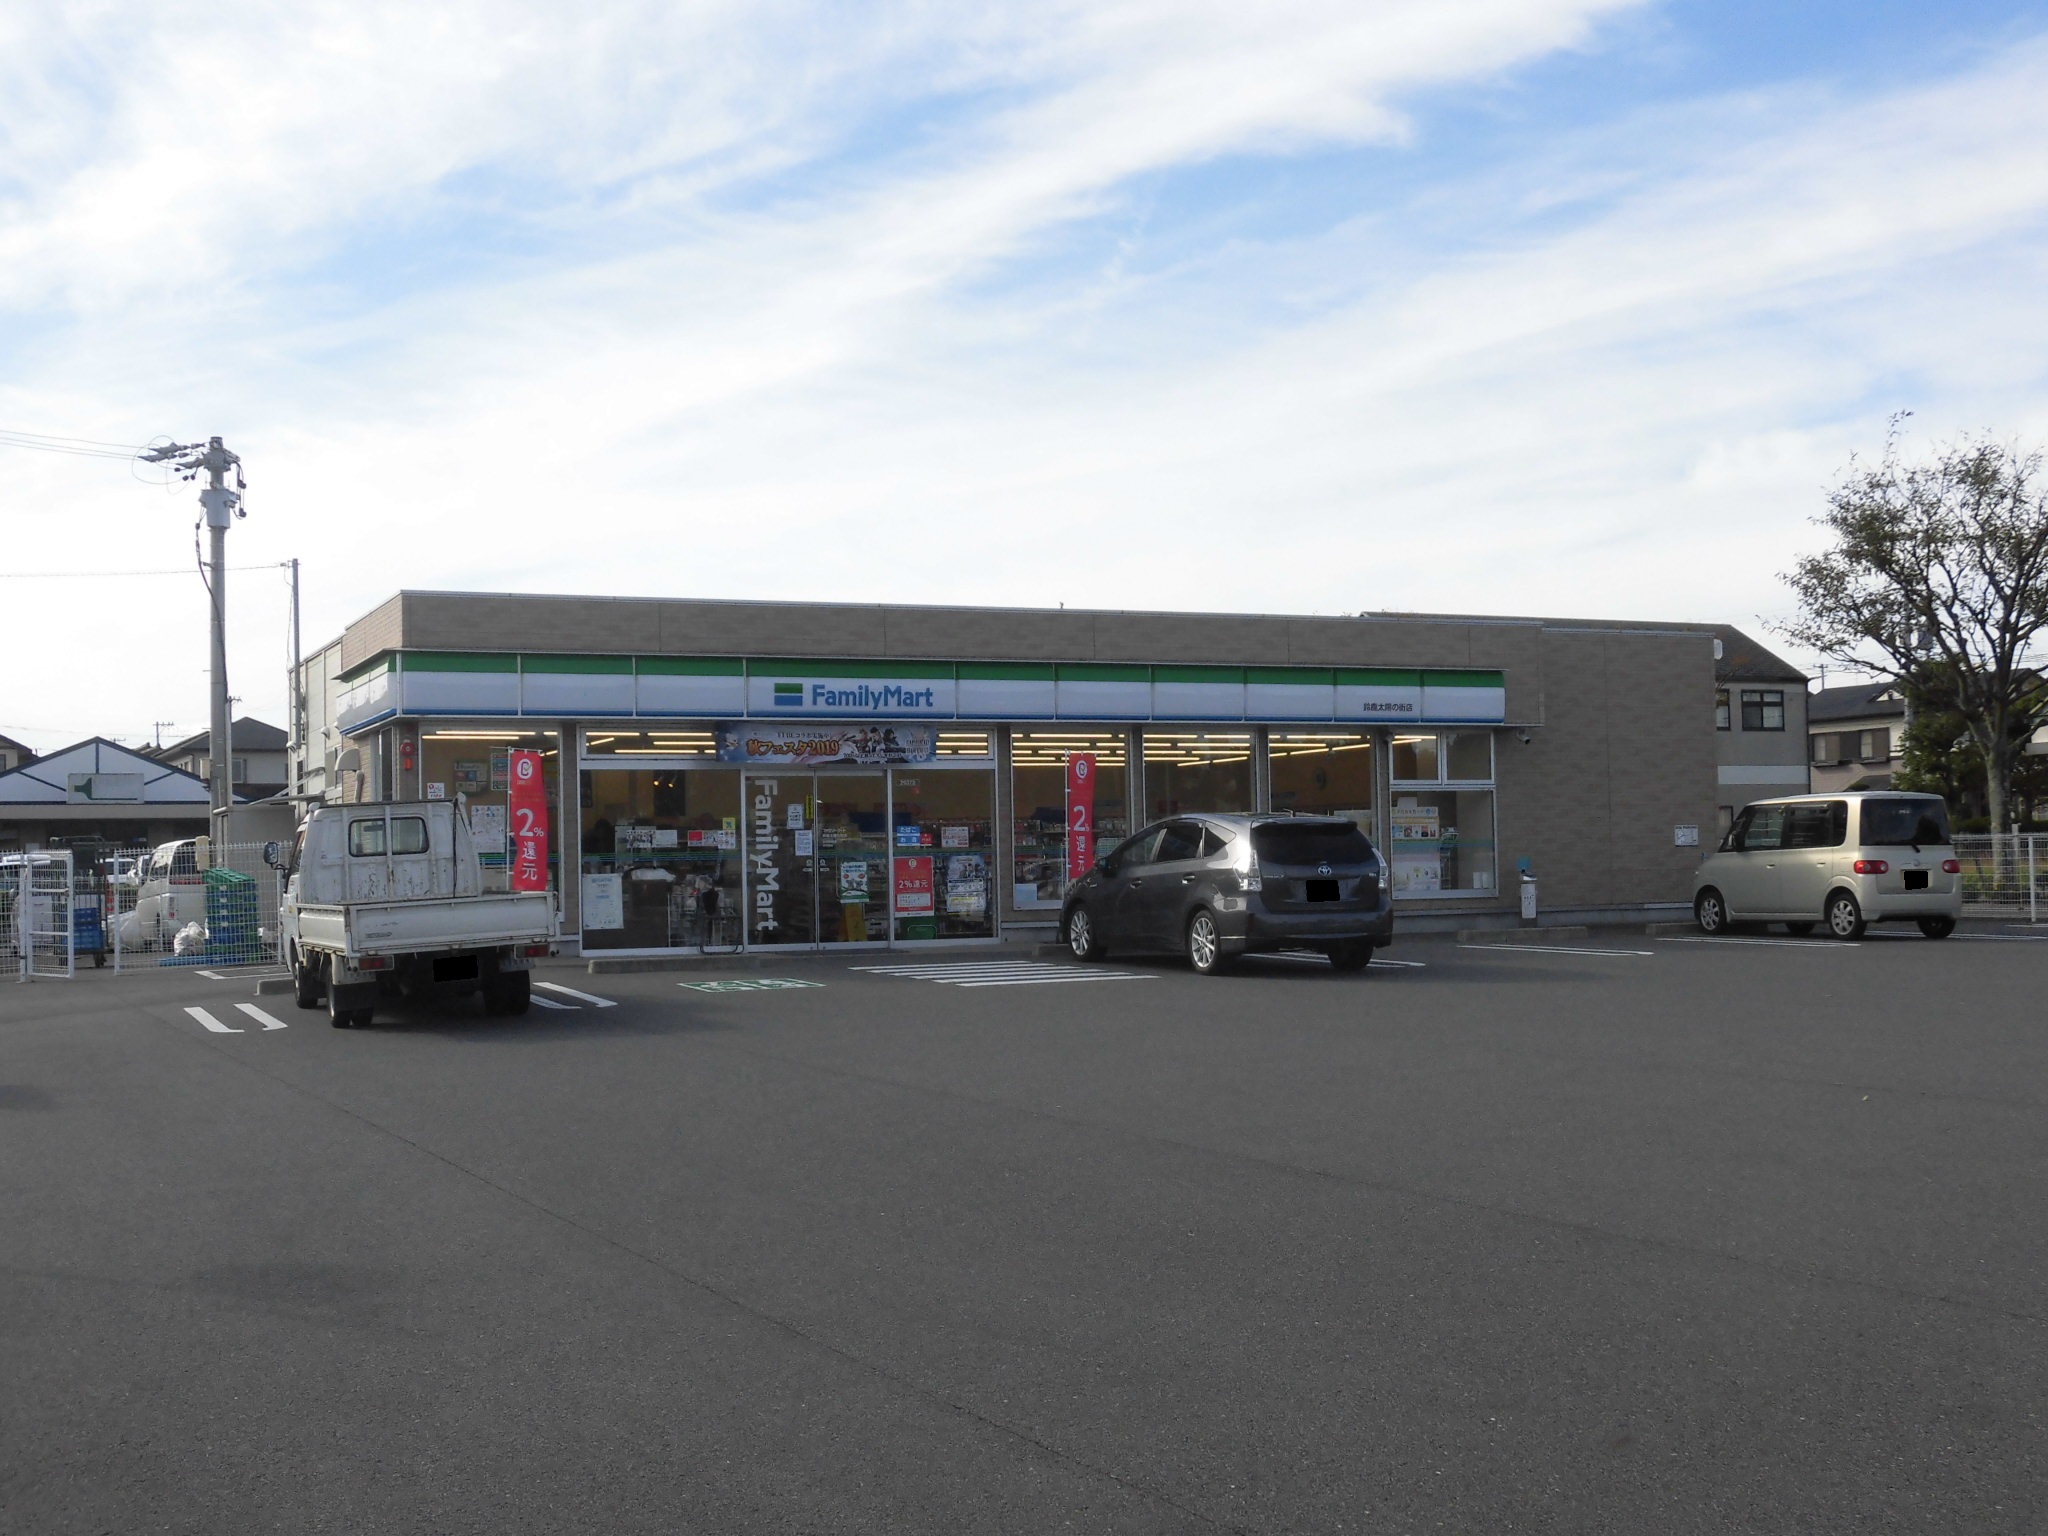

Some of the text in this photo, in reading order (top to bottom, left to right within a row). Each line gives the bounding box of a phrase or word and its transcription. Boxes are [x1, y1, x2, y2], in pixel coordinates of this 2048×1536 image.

[812, 684, 933, 710] FamilyMart
[746, 738, 840, 757] 秋フェスタ2019
[516, 808, 544, 838] 2%
[521, 841, 538, 880] 還元
[750, 779, 780, 930] FamilyMart
